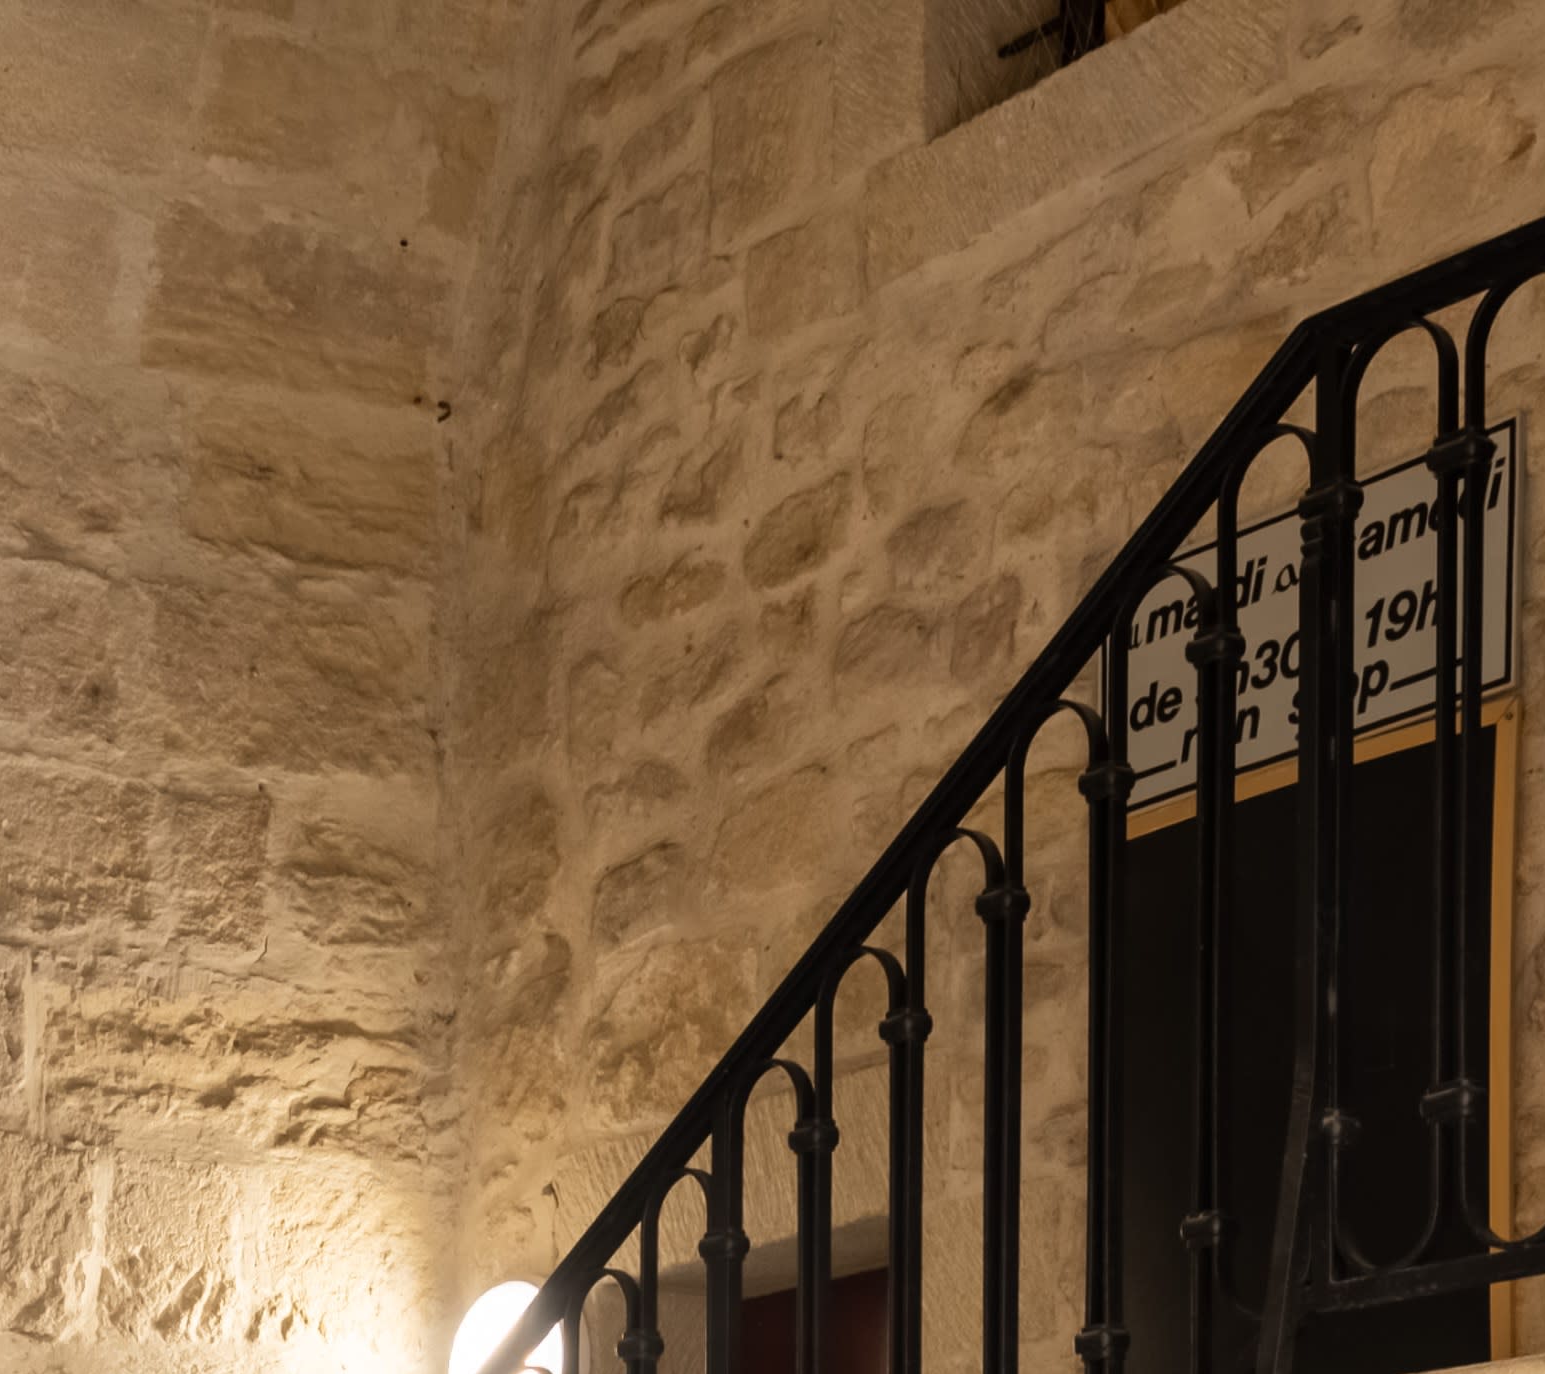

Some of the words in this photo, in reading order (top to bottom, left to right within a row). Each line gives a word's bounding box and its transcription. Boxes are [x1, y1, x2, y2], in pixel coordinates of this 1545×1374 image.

[1130, 680, 1183, 732] de
[1365, 580, 1438, 648] 19h
[1146, 556, 1268, 644] madi
